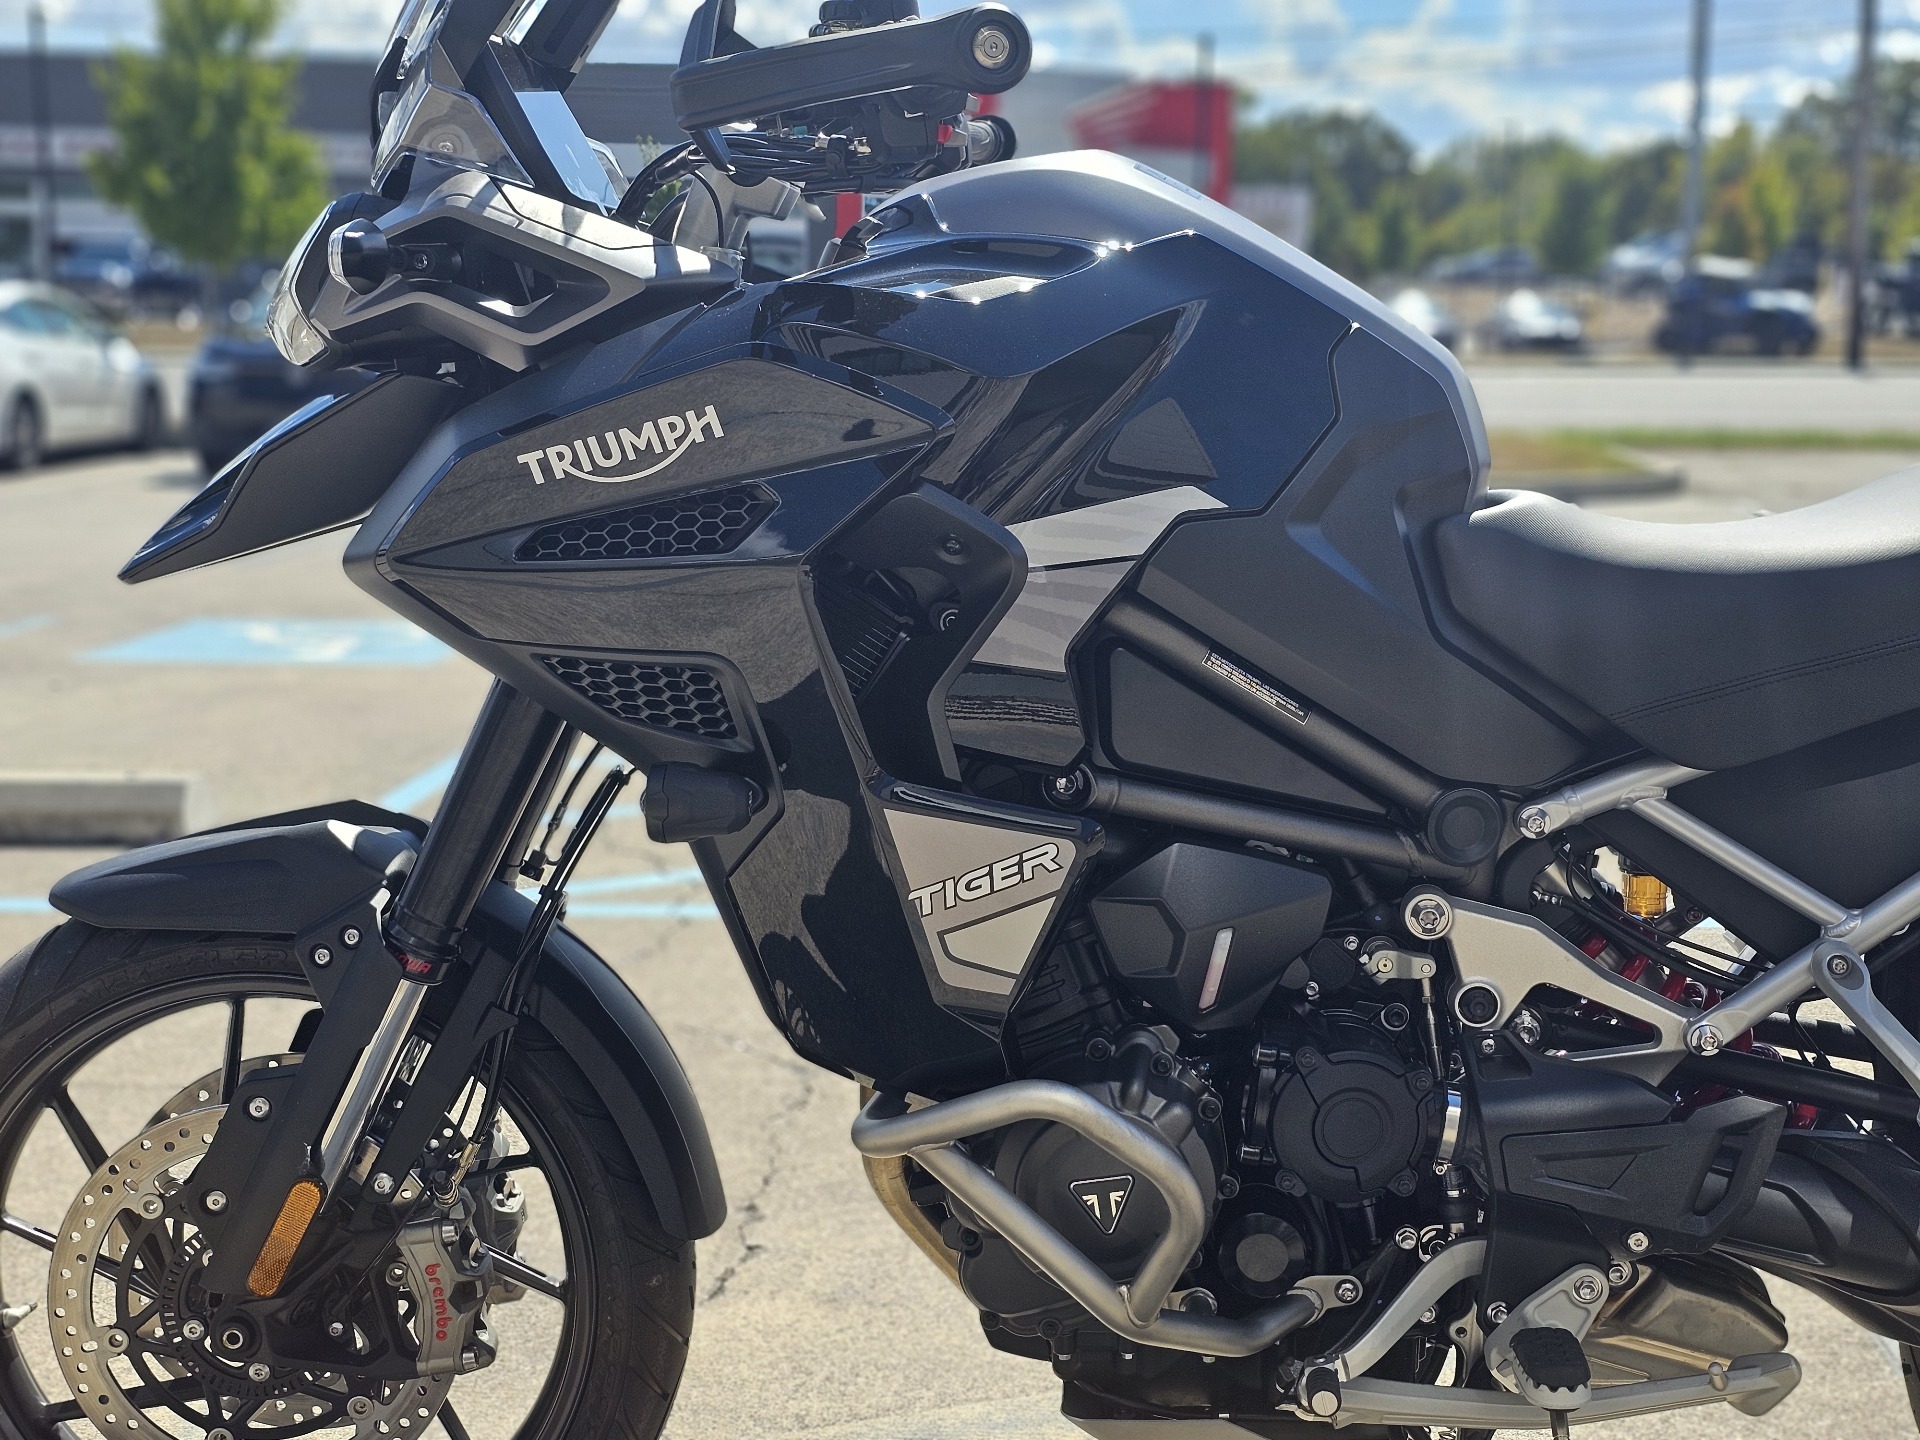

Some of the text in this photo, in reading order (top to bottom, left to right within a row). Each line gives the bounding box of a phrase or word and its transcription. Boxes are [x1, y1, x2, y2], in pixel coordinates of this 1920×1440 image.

[516, 404, 724, 485] TRIUMPH
[908, 842, 1064, 918] TIGER
[425, 1263, 452, 1341] brembo
